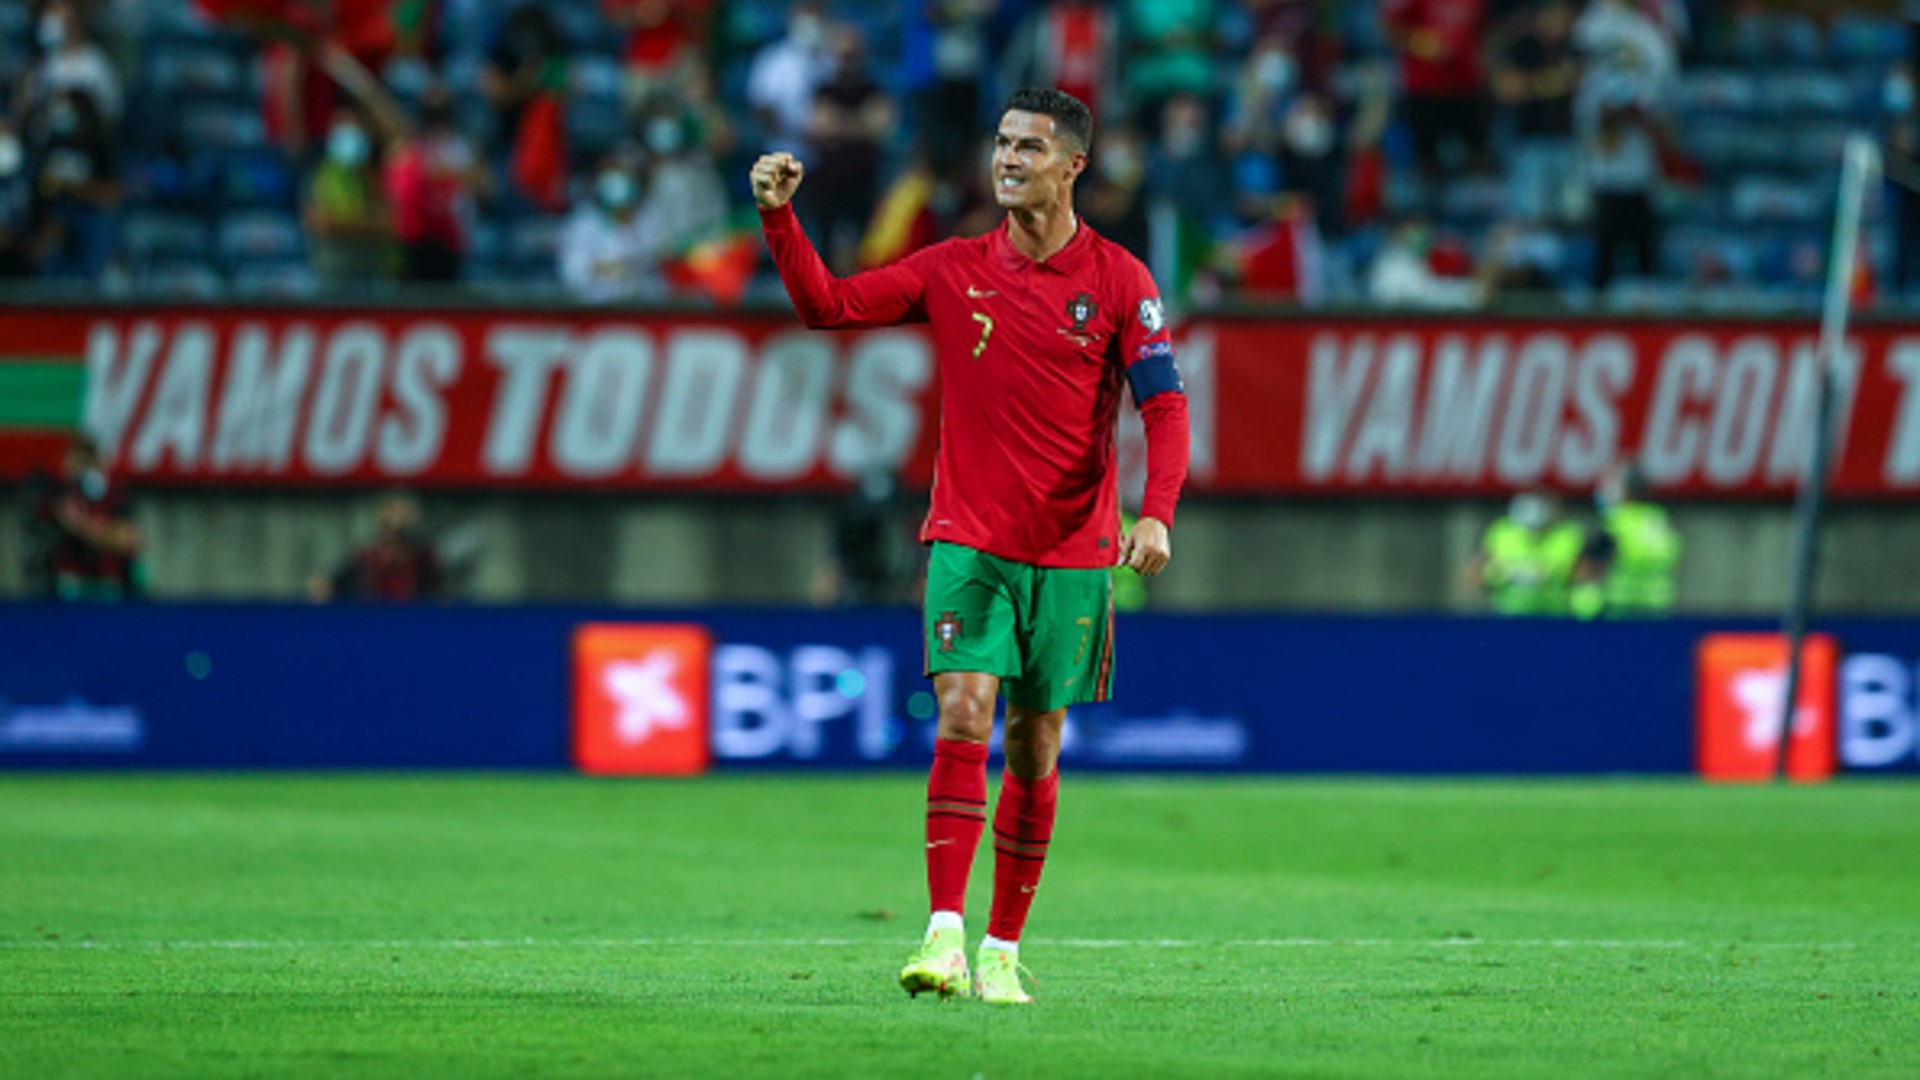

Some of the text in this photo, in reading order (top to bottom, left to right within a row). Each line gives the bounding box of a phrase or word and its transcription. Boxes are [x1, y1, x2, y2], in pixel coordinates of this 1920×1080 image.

[972, 311, 993, 360] 7
[82, 321, 462, 474] VAMOS
[482, 325, 934, 478] TODOS
[1302, 333, 1637, 484] VAMOS
[1075, 617, 1092, 664] 7
[712, 645, 891, 760] BPI
[1840, 652, 1920, 767] B
